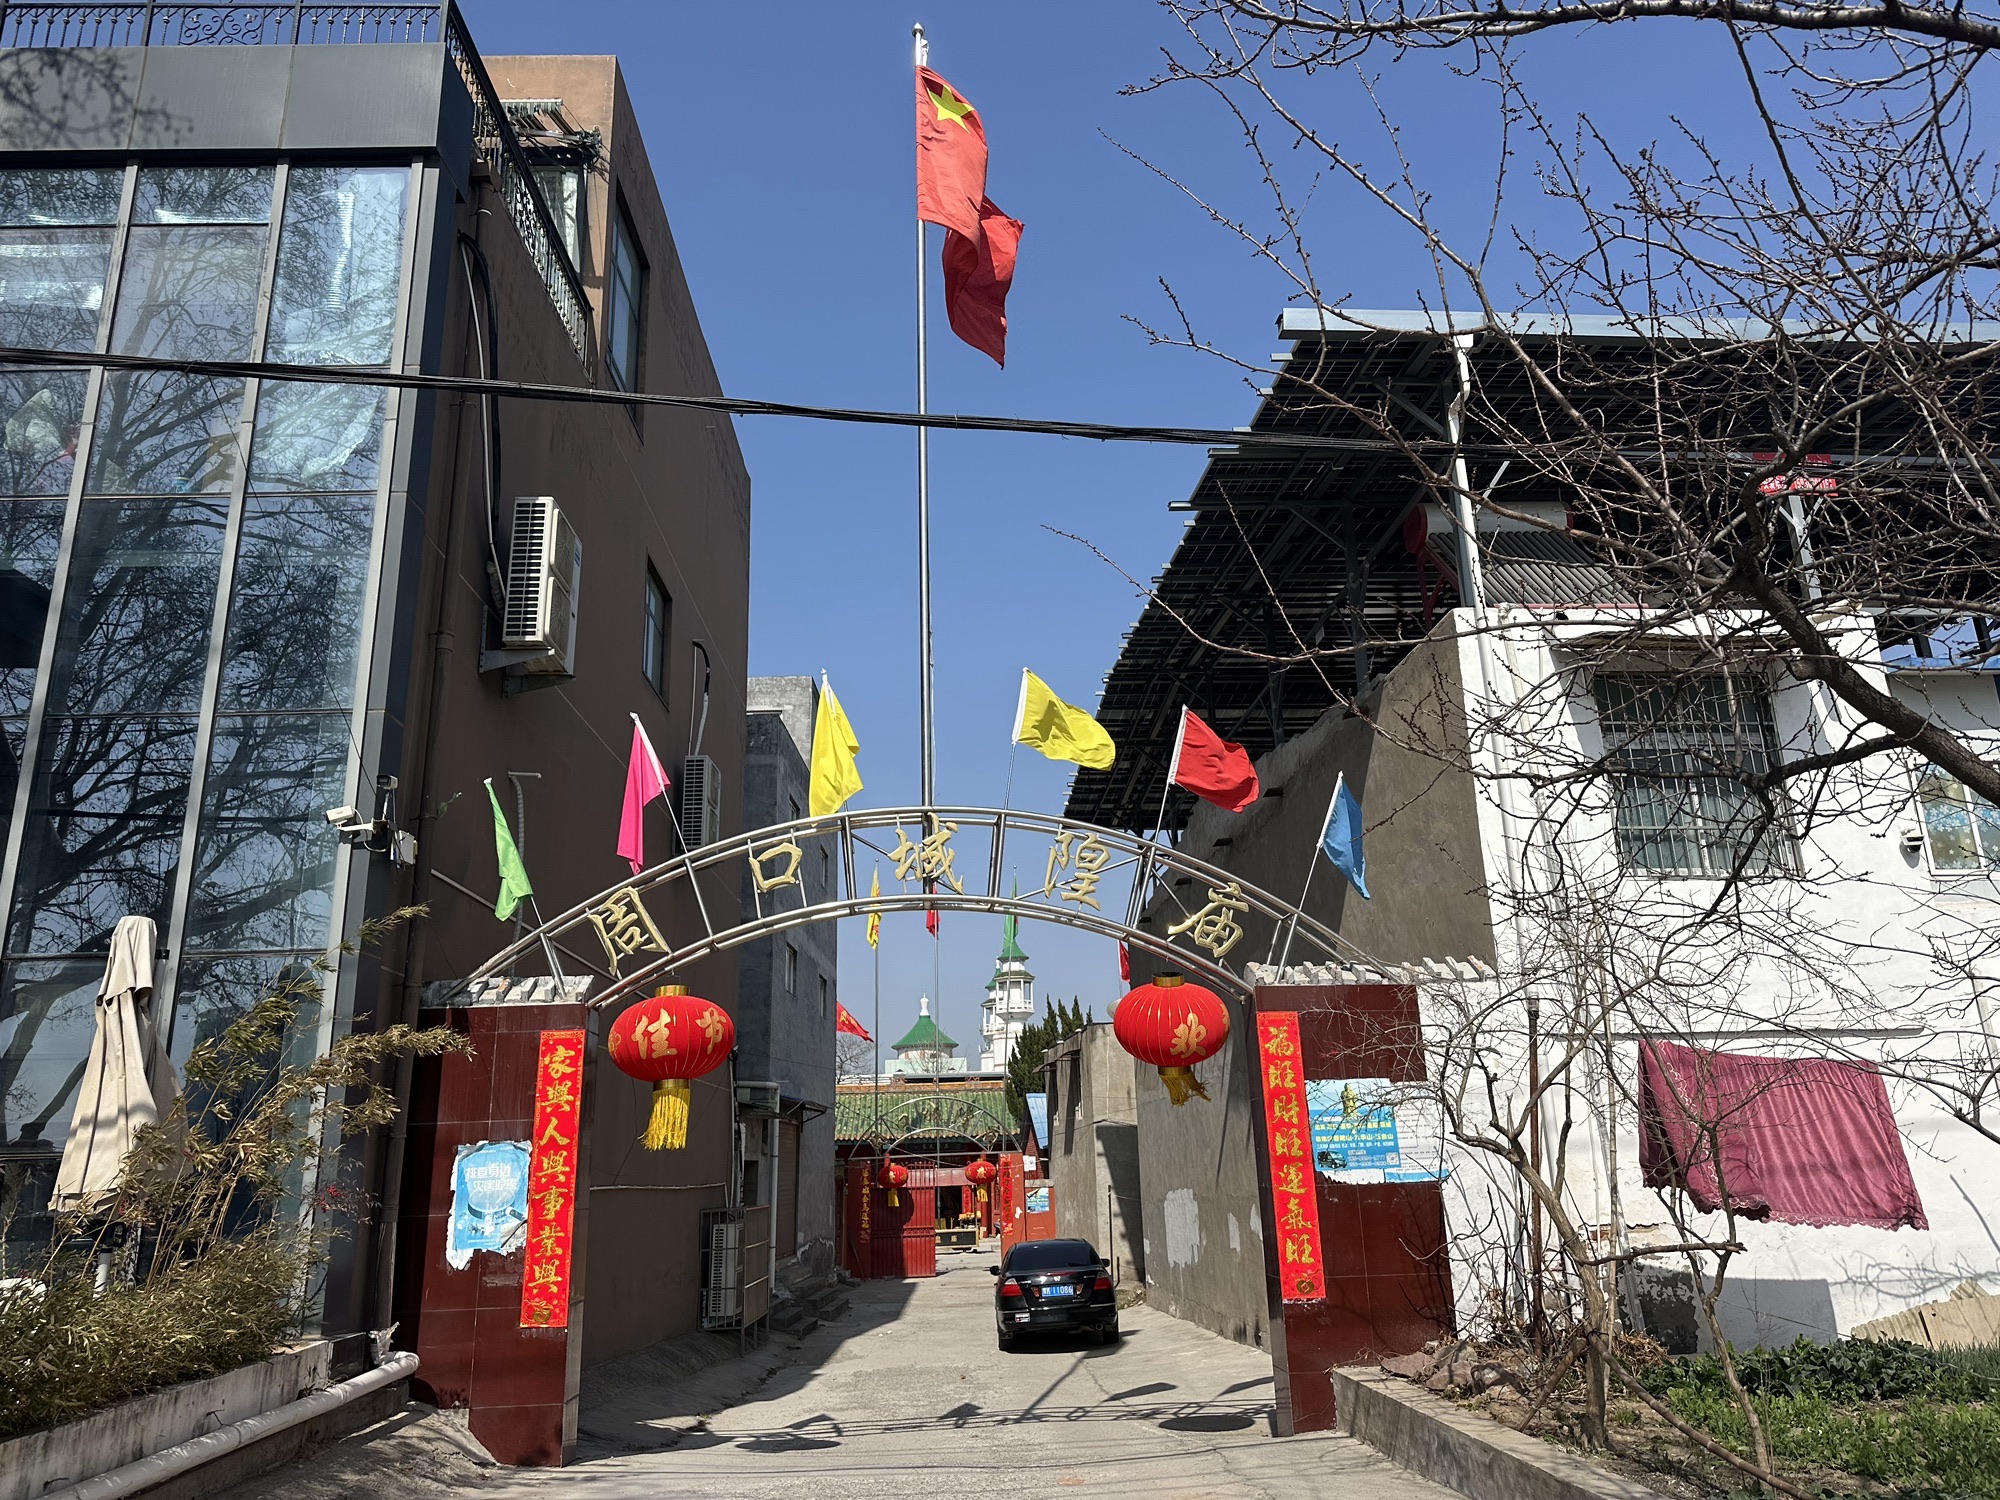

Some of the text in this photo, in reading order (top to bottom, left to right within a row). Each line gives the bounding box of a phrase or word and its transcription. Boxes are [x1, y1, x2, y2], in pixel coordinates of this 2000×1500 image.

[587, 812, 1249, 975] 周口城隍庙
[631, 1007, 727, 1060] 佳节
[465, 1164, 511, 1179] 排查身边
